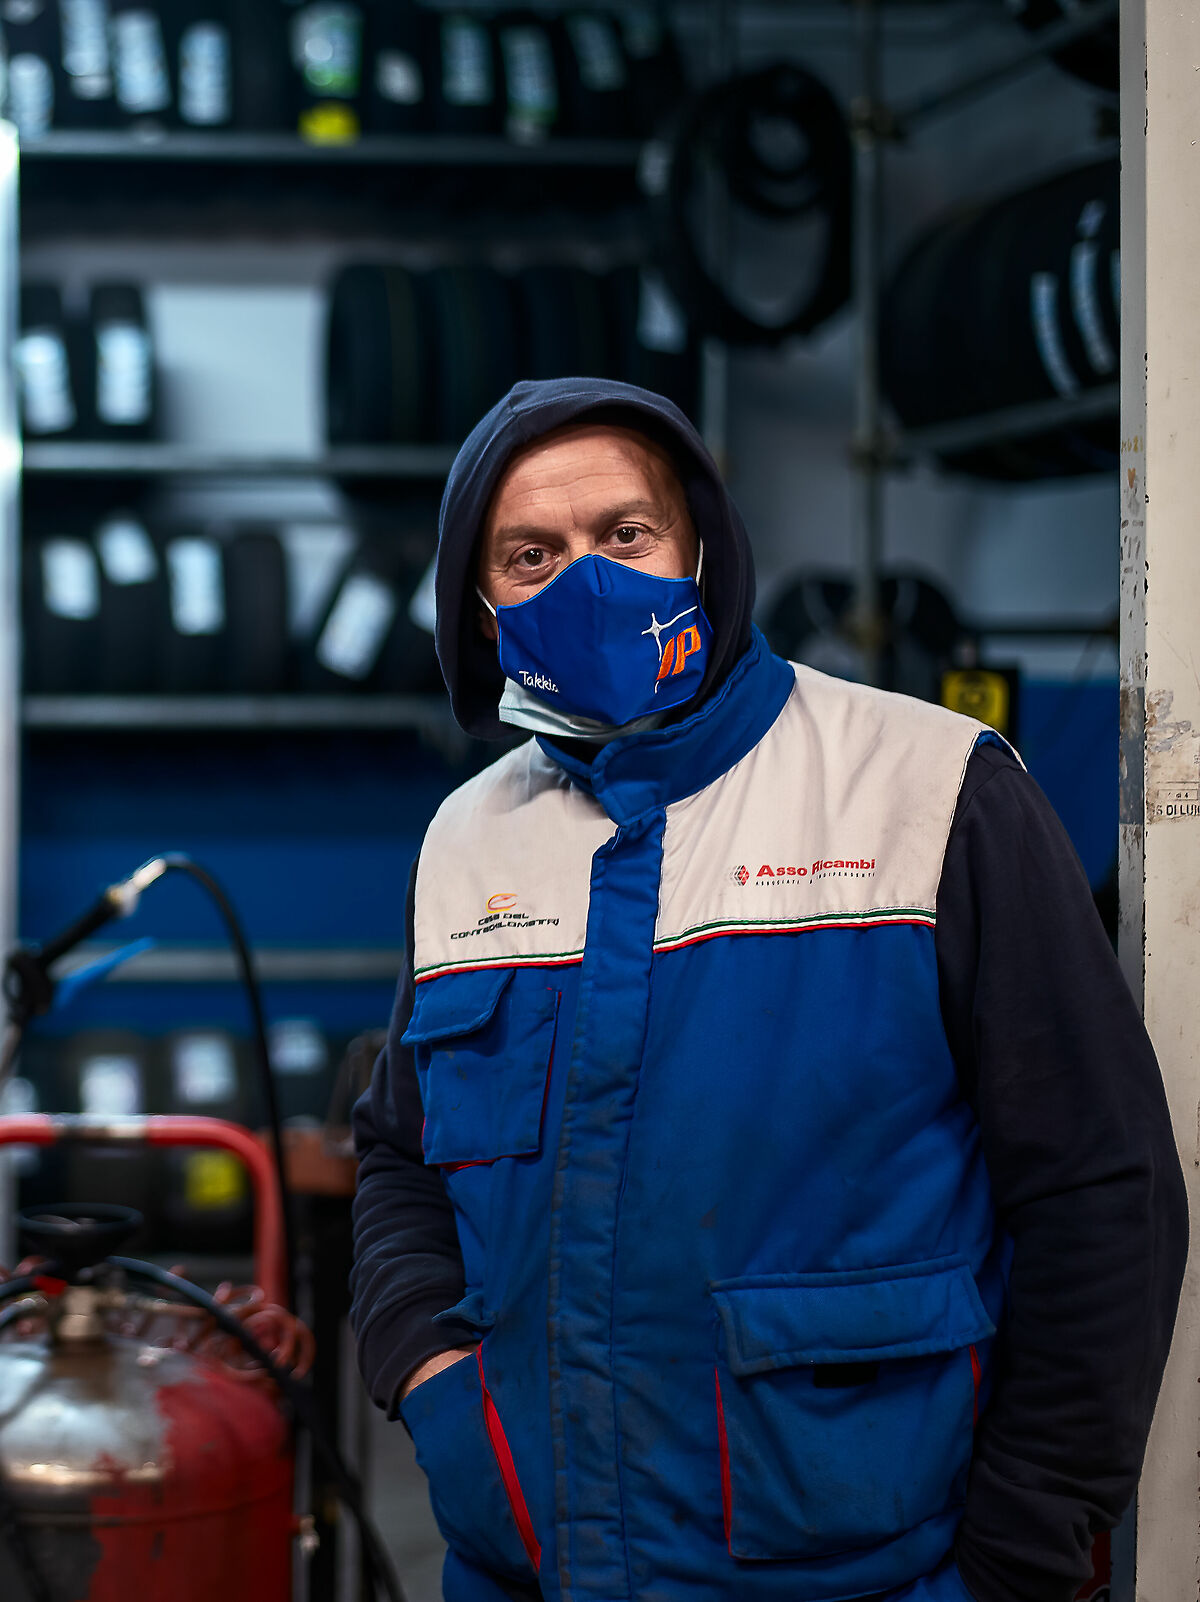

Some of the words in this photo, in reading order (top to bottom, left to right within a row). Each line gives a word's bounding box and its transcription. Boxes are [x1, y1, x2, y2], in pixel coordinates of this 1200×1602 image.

[756, 864, 808, 877] Asso
[812, 858, 876, 876] Ricambi
[503, 912, 530, 920] DEL
